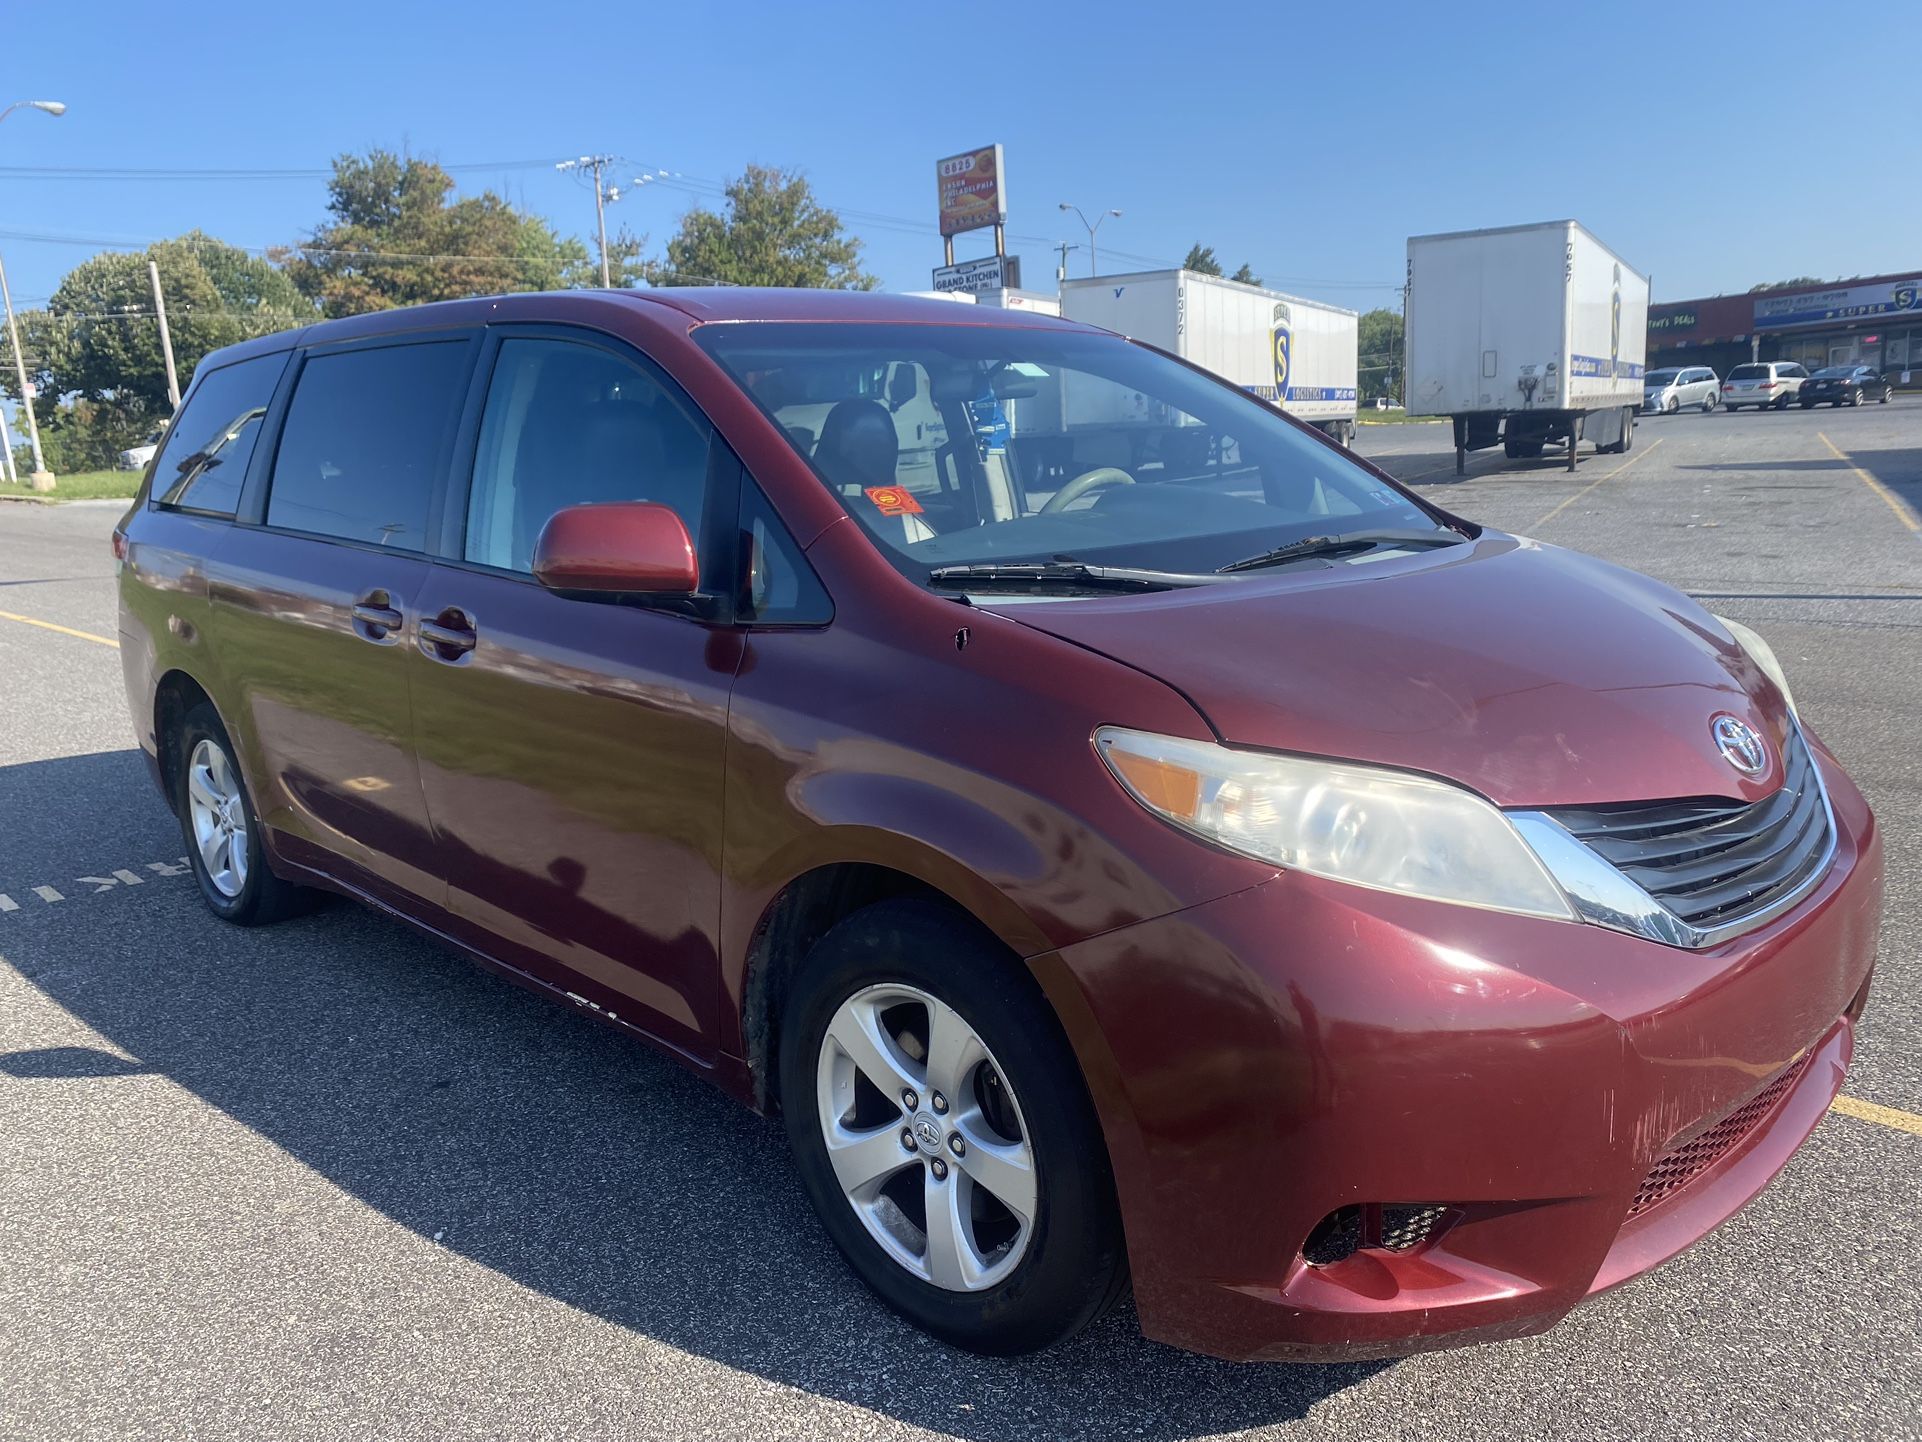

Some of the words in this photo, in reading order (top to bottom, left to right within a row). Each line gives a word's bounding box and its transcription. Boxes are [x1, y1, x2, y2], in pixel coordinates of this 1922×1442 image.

[943, 180, 994, 198] PHILADELPHIA
[1565, 242, 1573, 282] 7057
[936, 276, 964, 289] GRAND
[966, 268, 999, 283] KITCHEN
[1839, 303, 1886, 317] SUPER
